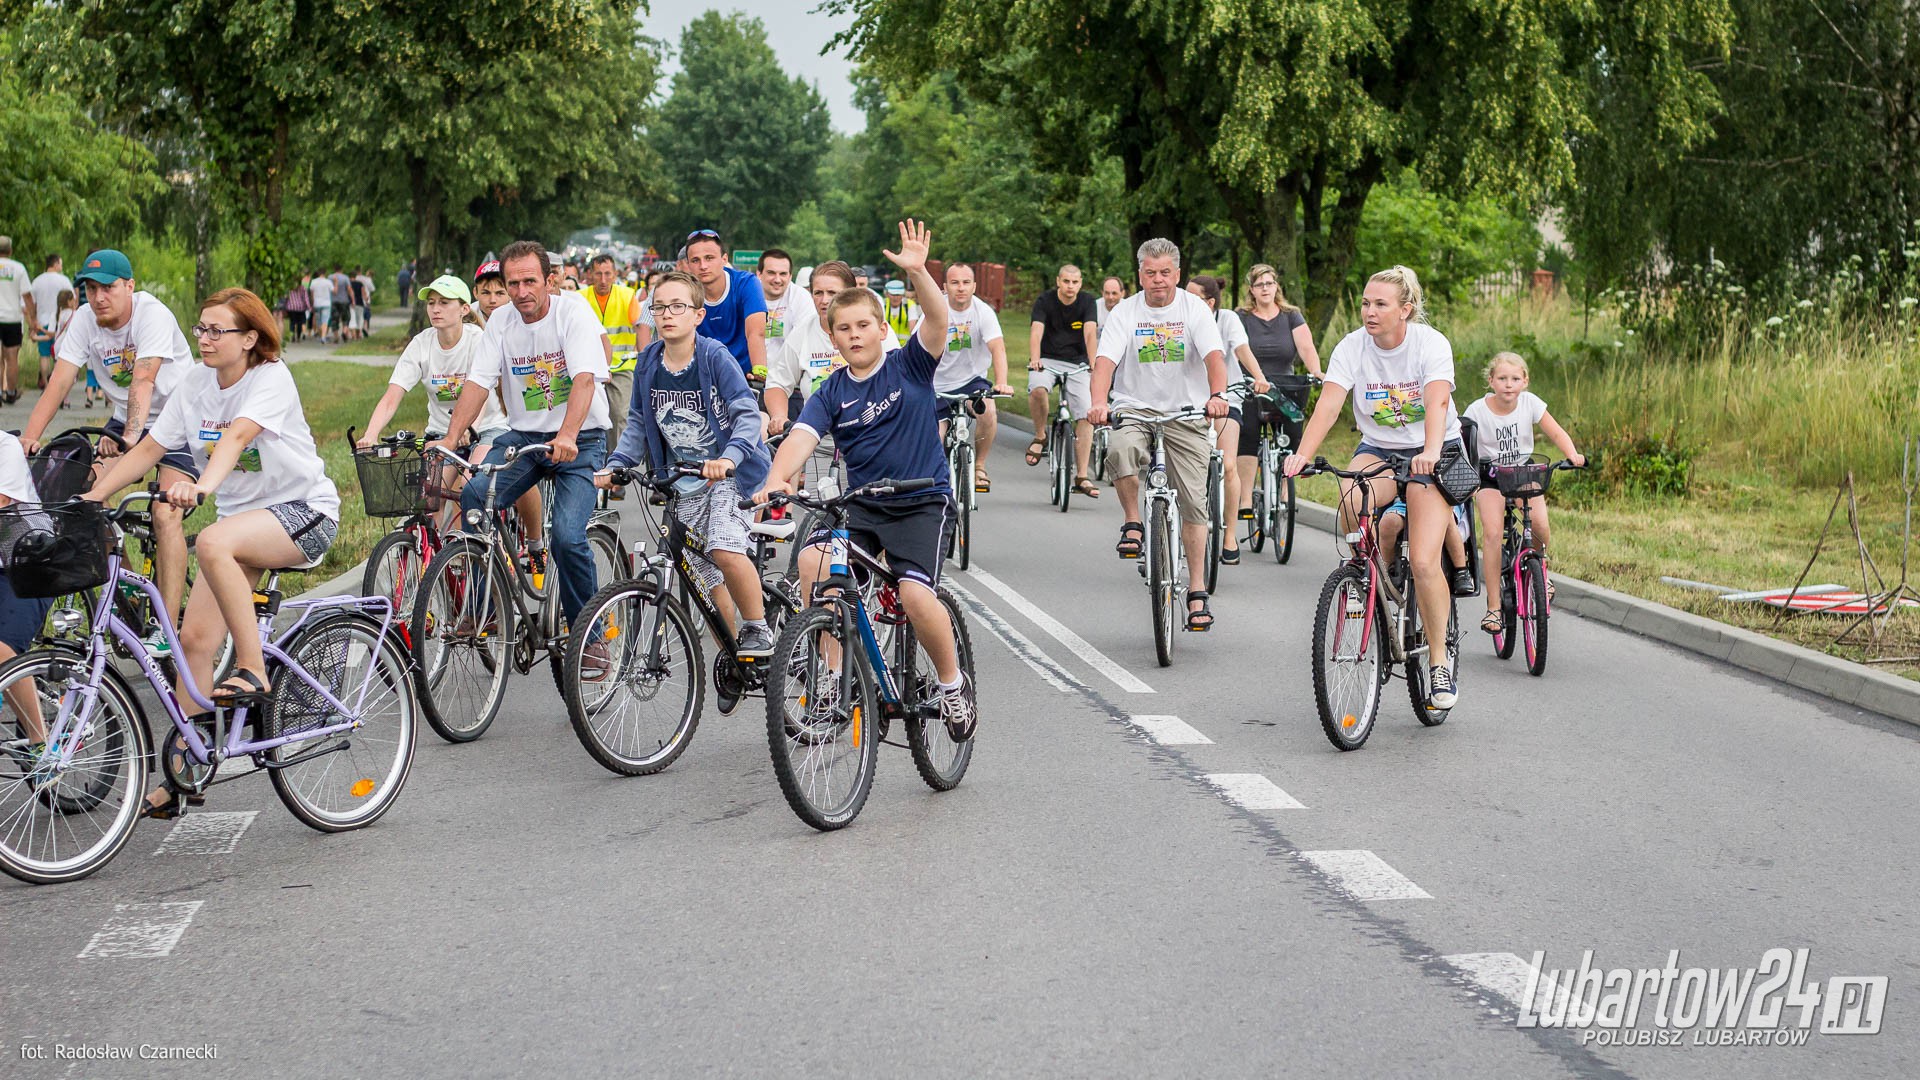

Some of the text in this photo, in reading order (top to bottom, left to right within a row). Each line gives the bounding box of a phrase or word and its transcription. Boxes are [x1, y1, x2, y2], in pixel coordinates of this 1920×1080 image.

[1495, 422, 1519, 441] DON'T
[1499, 437, 1519, 452] OVER
[143, 653, 174, 695] ROMET
